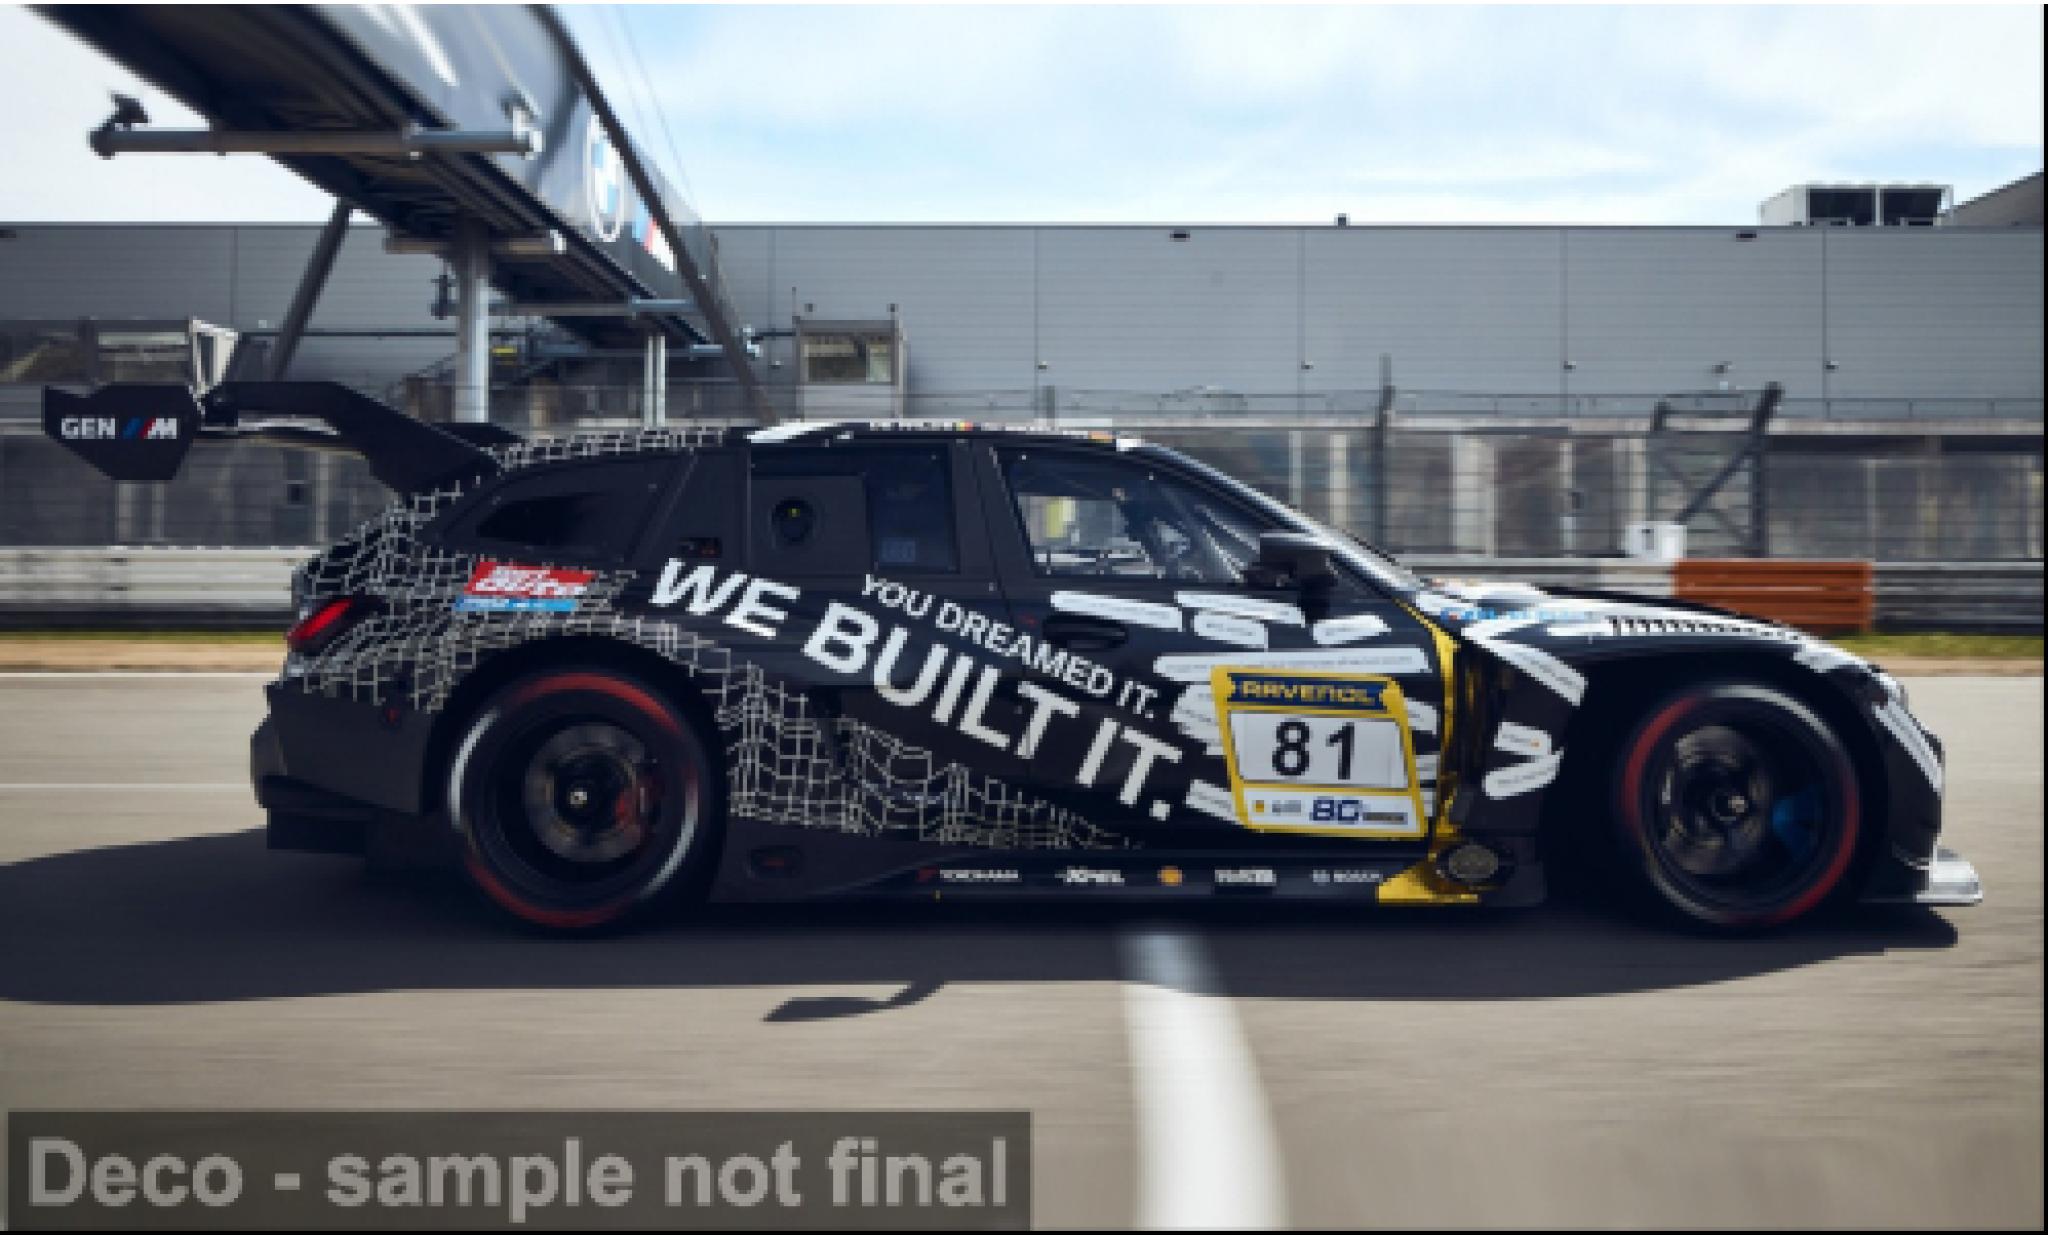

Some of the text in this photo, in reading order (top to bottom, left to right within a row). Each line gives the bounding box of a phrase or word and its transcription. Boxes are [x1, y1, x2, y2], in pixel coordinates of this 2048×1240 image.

[61, 416, 116, 440] GEN
[861, 574, 1160, 719] YOU DREAMED IT.
[649, 557, 1182, 821] WE BUILT IT.
[1242, 680, 1375, 705] RAVENOL
[1271, 720, 1356, 781] 81
